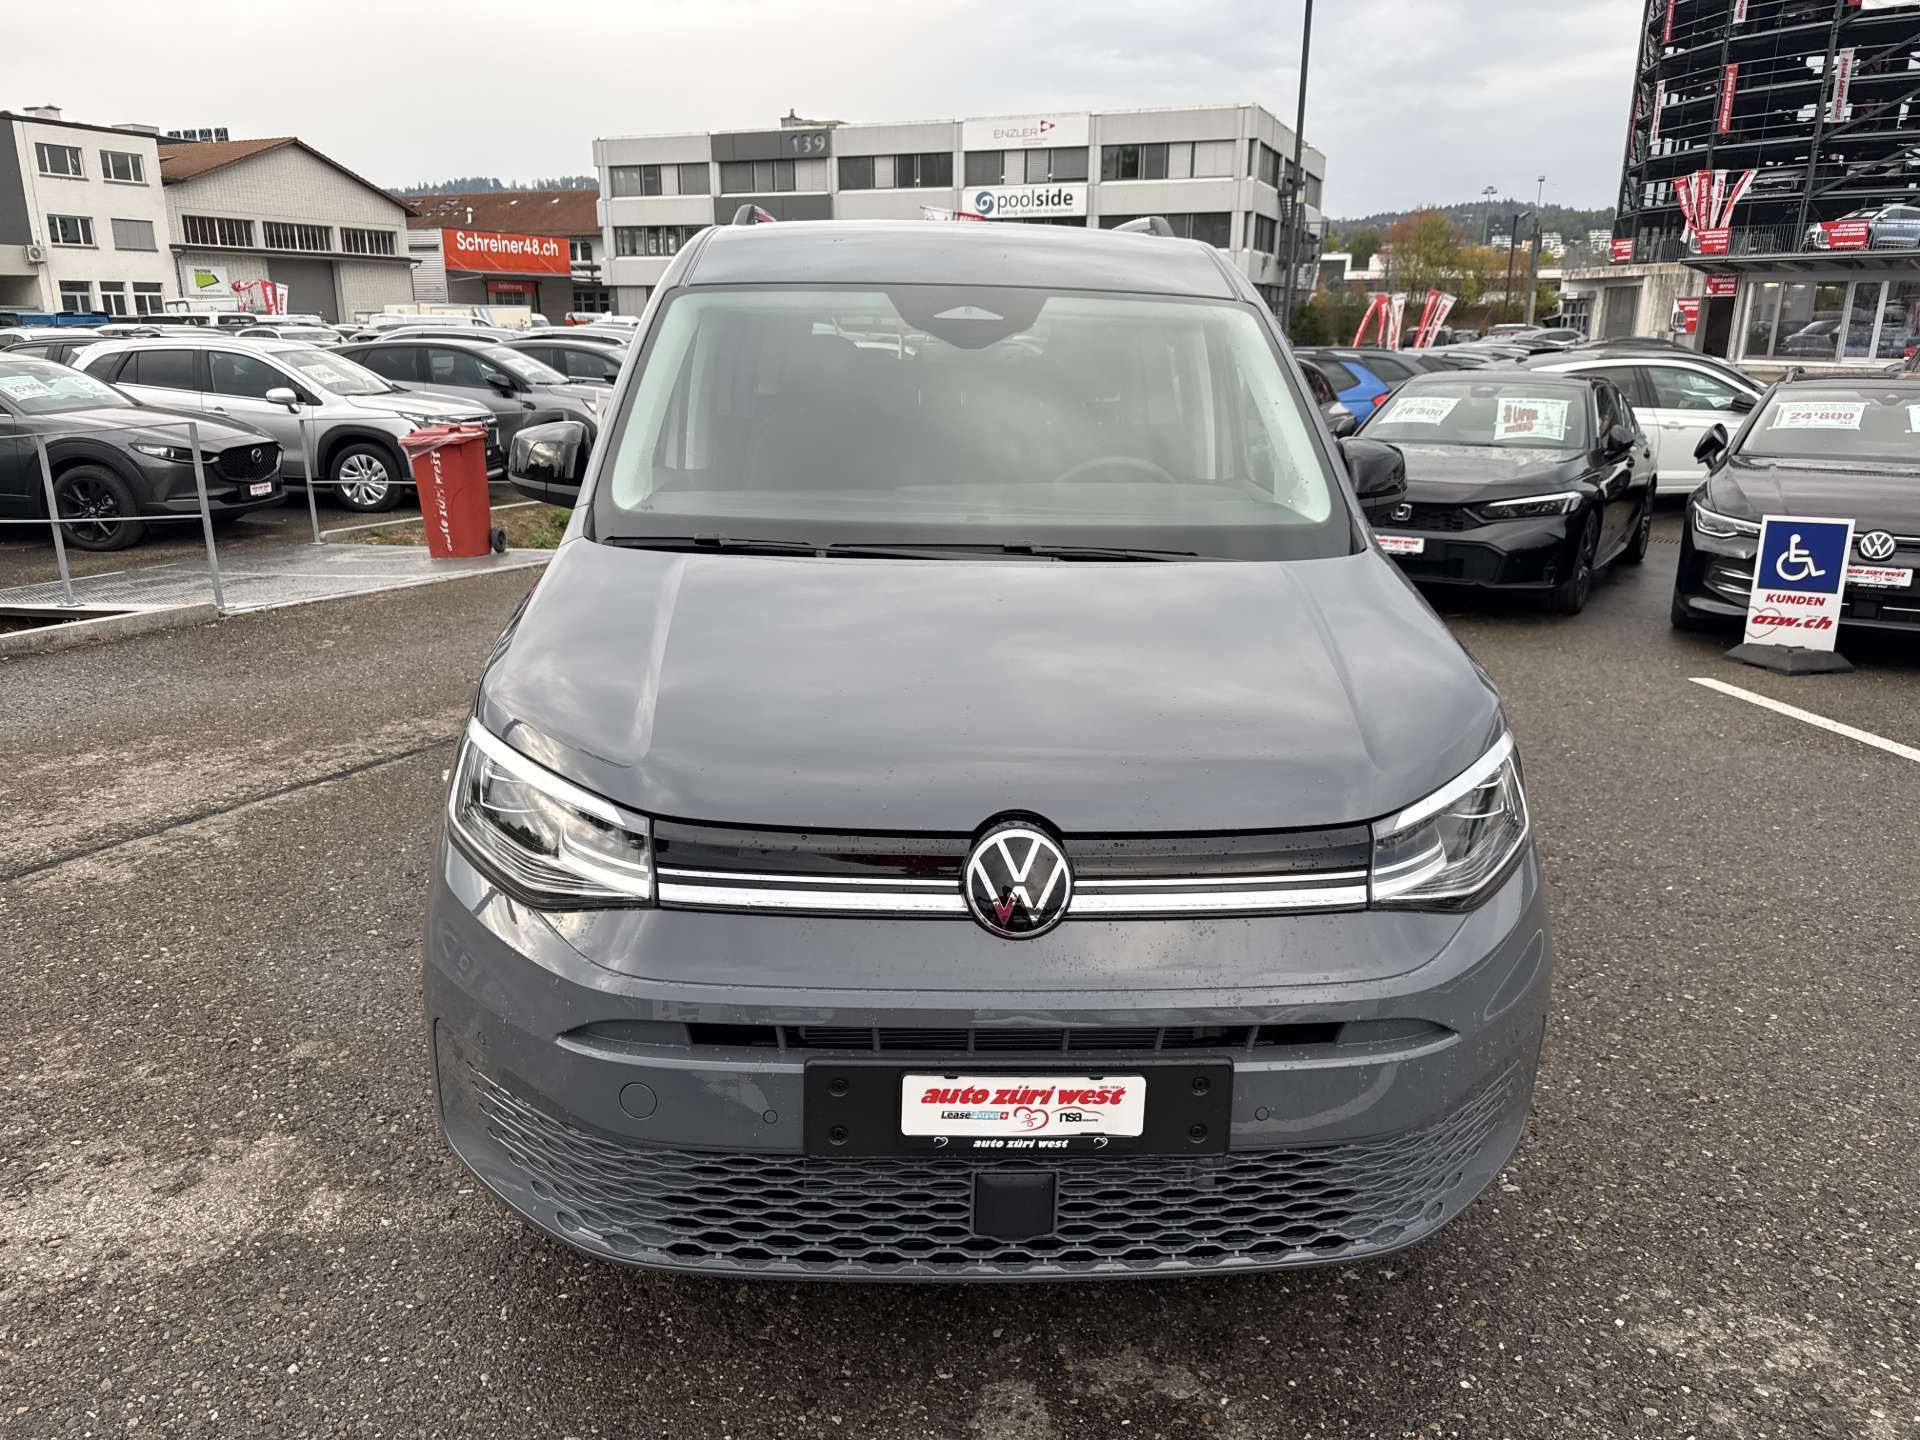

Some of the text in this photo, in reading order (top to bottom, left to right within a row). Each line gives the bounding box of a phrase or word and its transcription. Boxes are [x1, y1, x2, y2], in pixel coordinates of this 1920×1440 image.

[993, 127, 1039, 139] ENZLER
[790, 134, 826, 153] 139
[997, 188, 1074, 215] poolside
[456, 231, 559, 257] Schreiner48.ch
[1790, 411, 1855, 420] 24'800
[1765, 593, 1826, 607] KUNDEN
[1752, 615, 1833, 631] azw.ch
[921, 1085, 1127, 1105] auto züri west
[1059, 1112, 1082, 1122] nsa
[973, 1138, 1069, 1148] auto züri west
